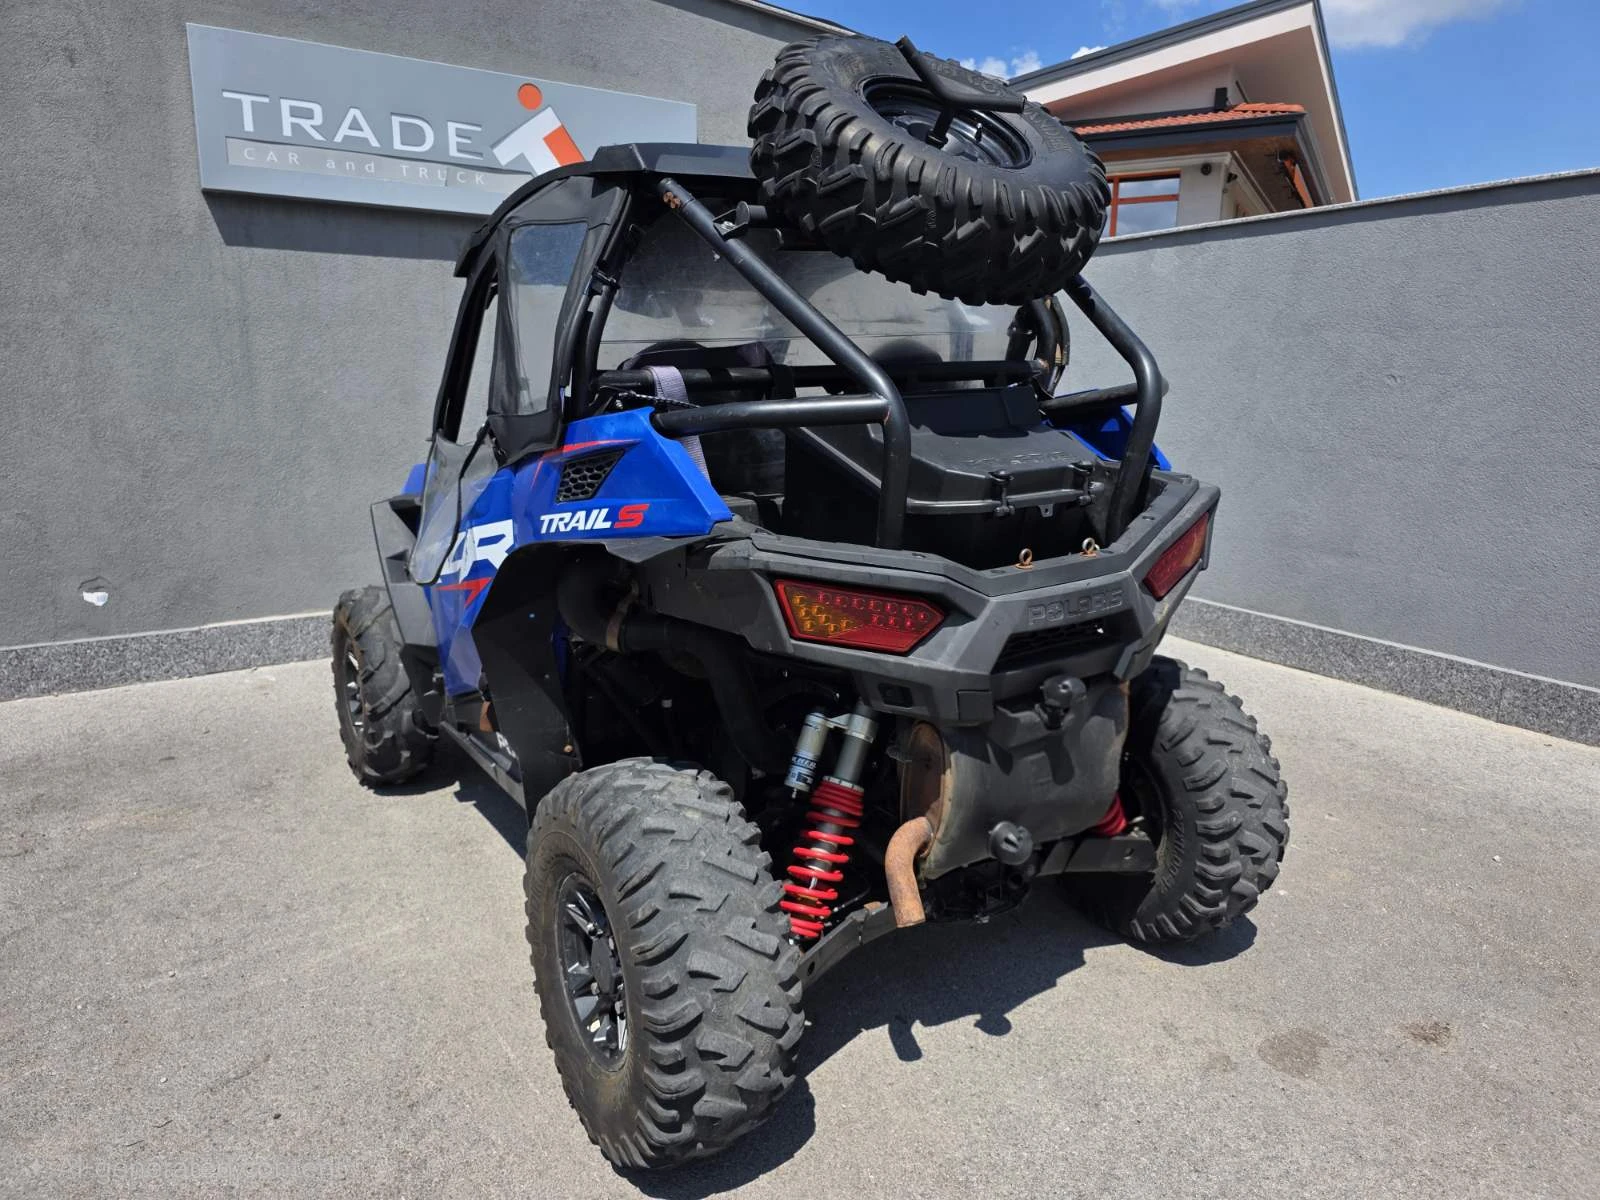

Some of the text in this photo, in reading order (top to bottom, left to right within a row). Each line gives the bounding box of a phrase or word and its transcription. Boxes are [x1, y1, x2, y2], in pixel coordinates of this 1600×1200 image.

[222, 90, 484, 160] TRADE
[243, 147, 486, 186] CAR and TRUCK
[539, 503, 650, 534] TRAIL S
